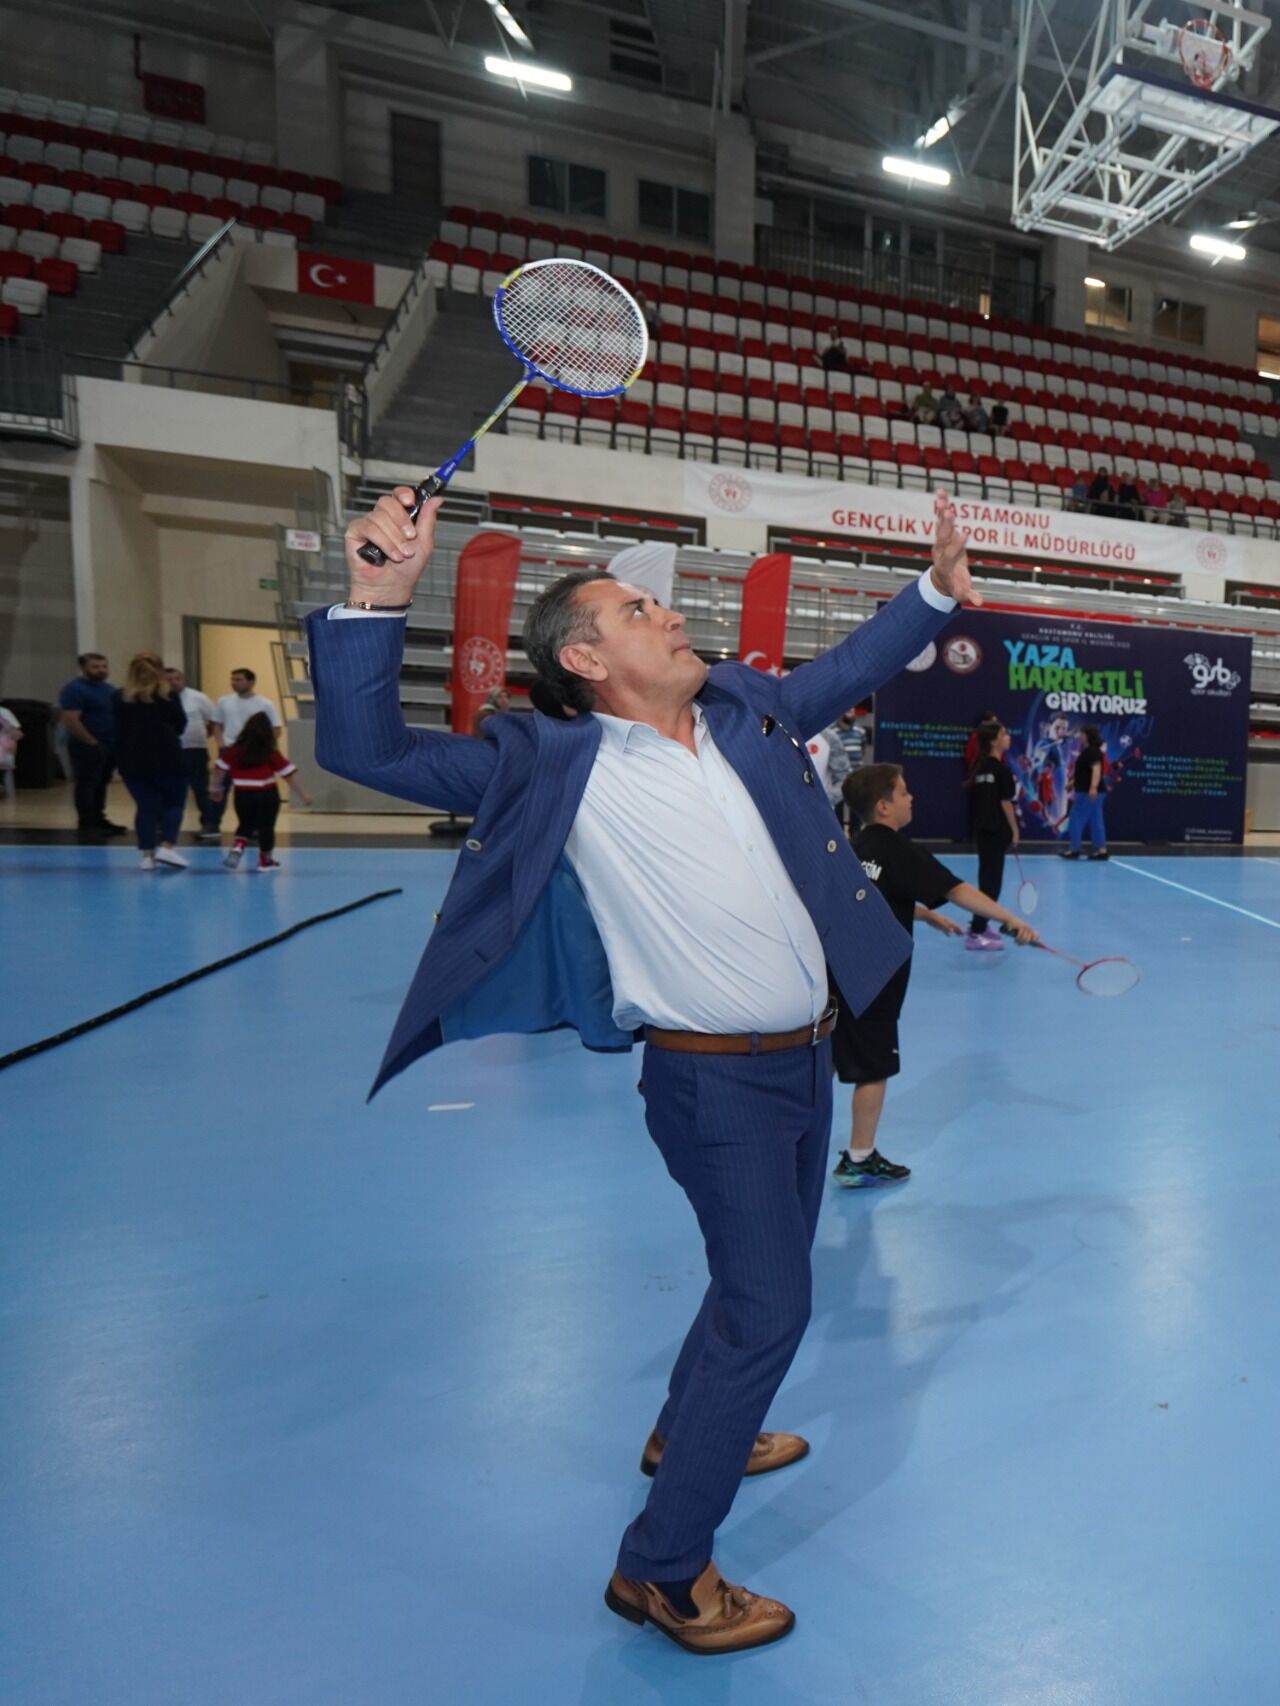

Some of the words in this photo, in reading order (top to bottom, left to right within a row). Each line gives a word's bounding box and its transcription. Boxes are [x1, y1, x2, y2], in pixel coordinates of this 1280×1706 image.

[832, 509, 916, 535] GENÇLİK
[1003, 528, 1018, 547] İL
[1024, 532, 1136, 562] MÜDÜRLÜĞÜ
[1003, 640, 1076, 669] YAZA
[1045, 691, 1148, 715] GİRİYORUZ
